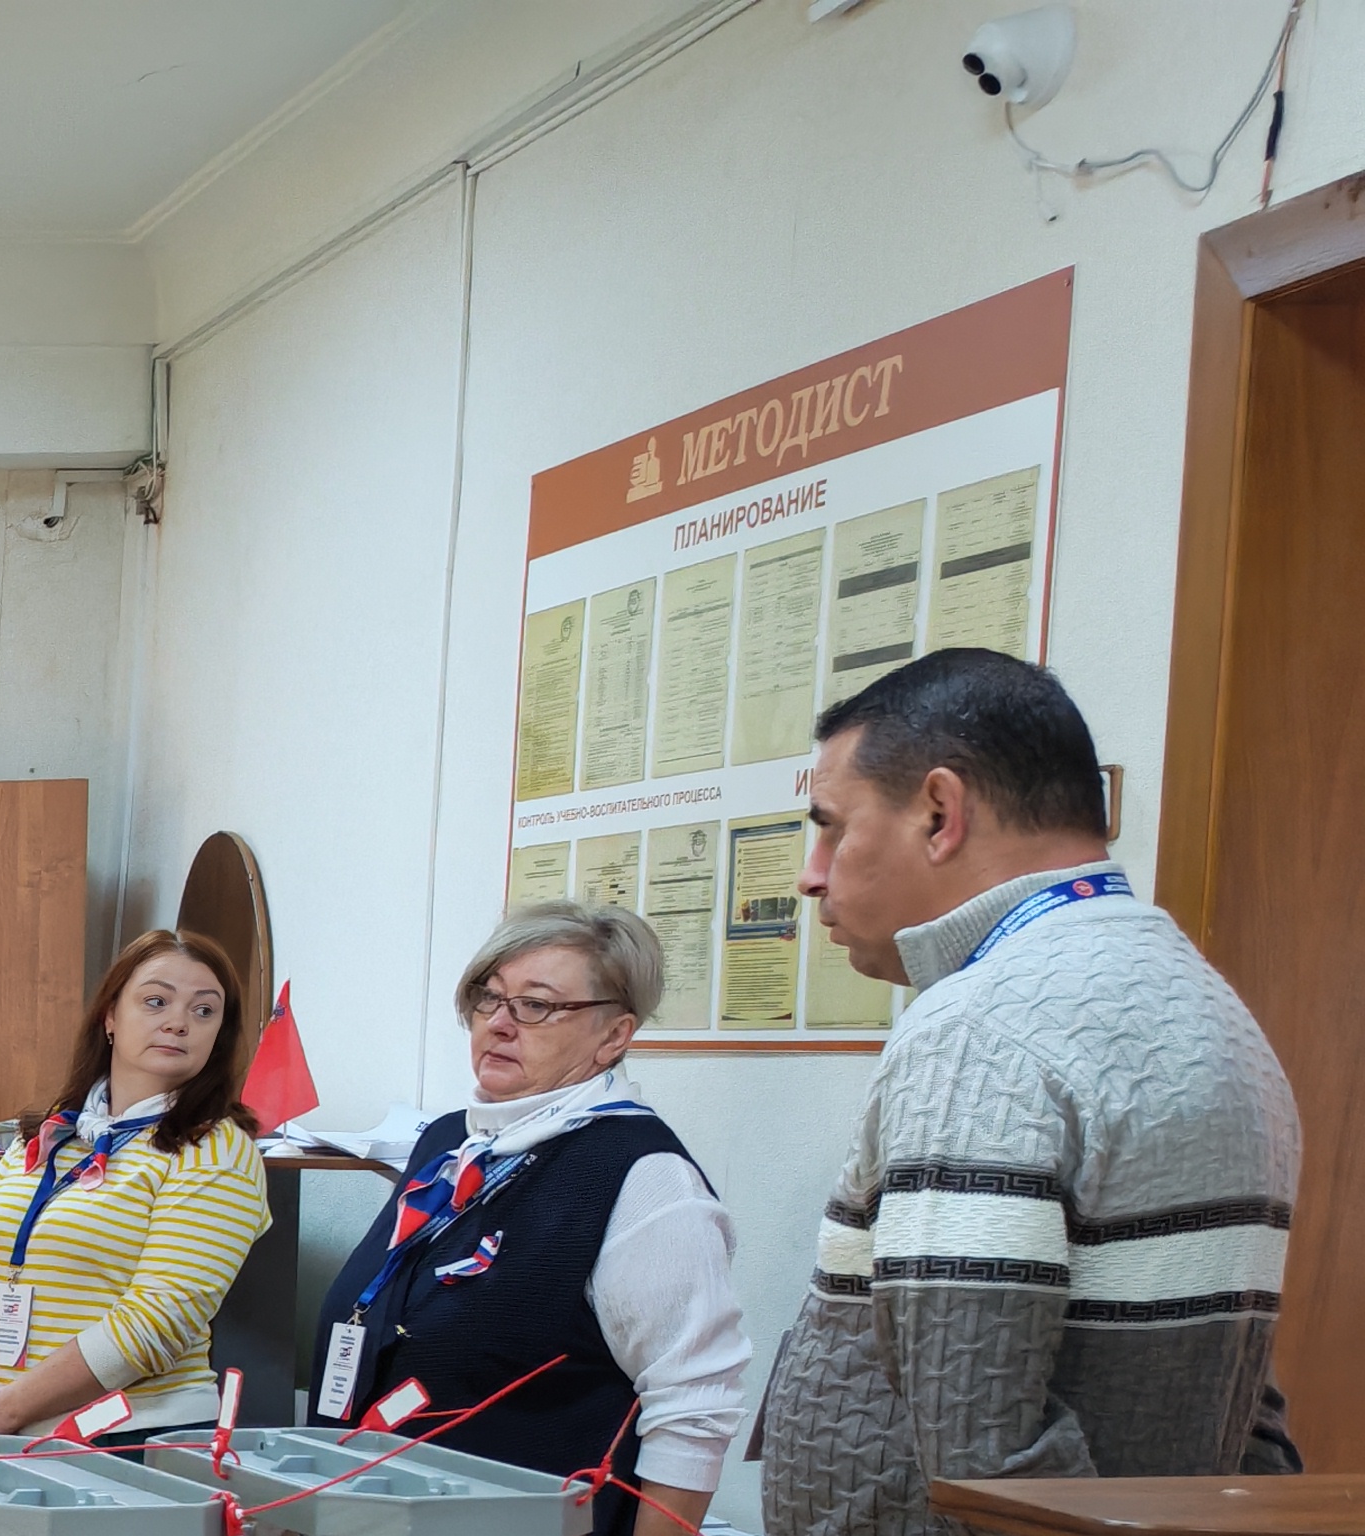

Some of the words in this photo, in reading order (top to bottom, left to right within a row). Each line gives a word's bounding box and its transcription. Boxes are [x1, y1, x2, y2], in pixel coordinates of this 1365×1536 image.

[676, 354, 905, 486] МЕТОДИСТ
[673, 479, 828, 552] ПЛАНИРОВАНИЕ
[517, 811, 555, 830] КОНТРОЛЬ
[671, 786, 722, 806] ПРОЦЕССА
